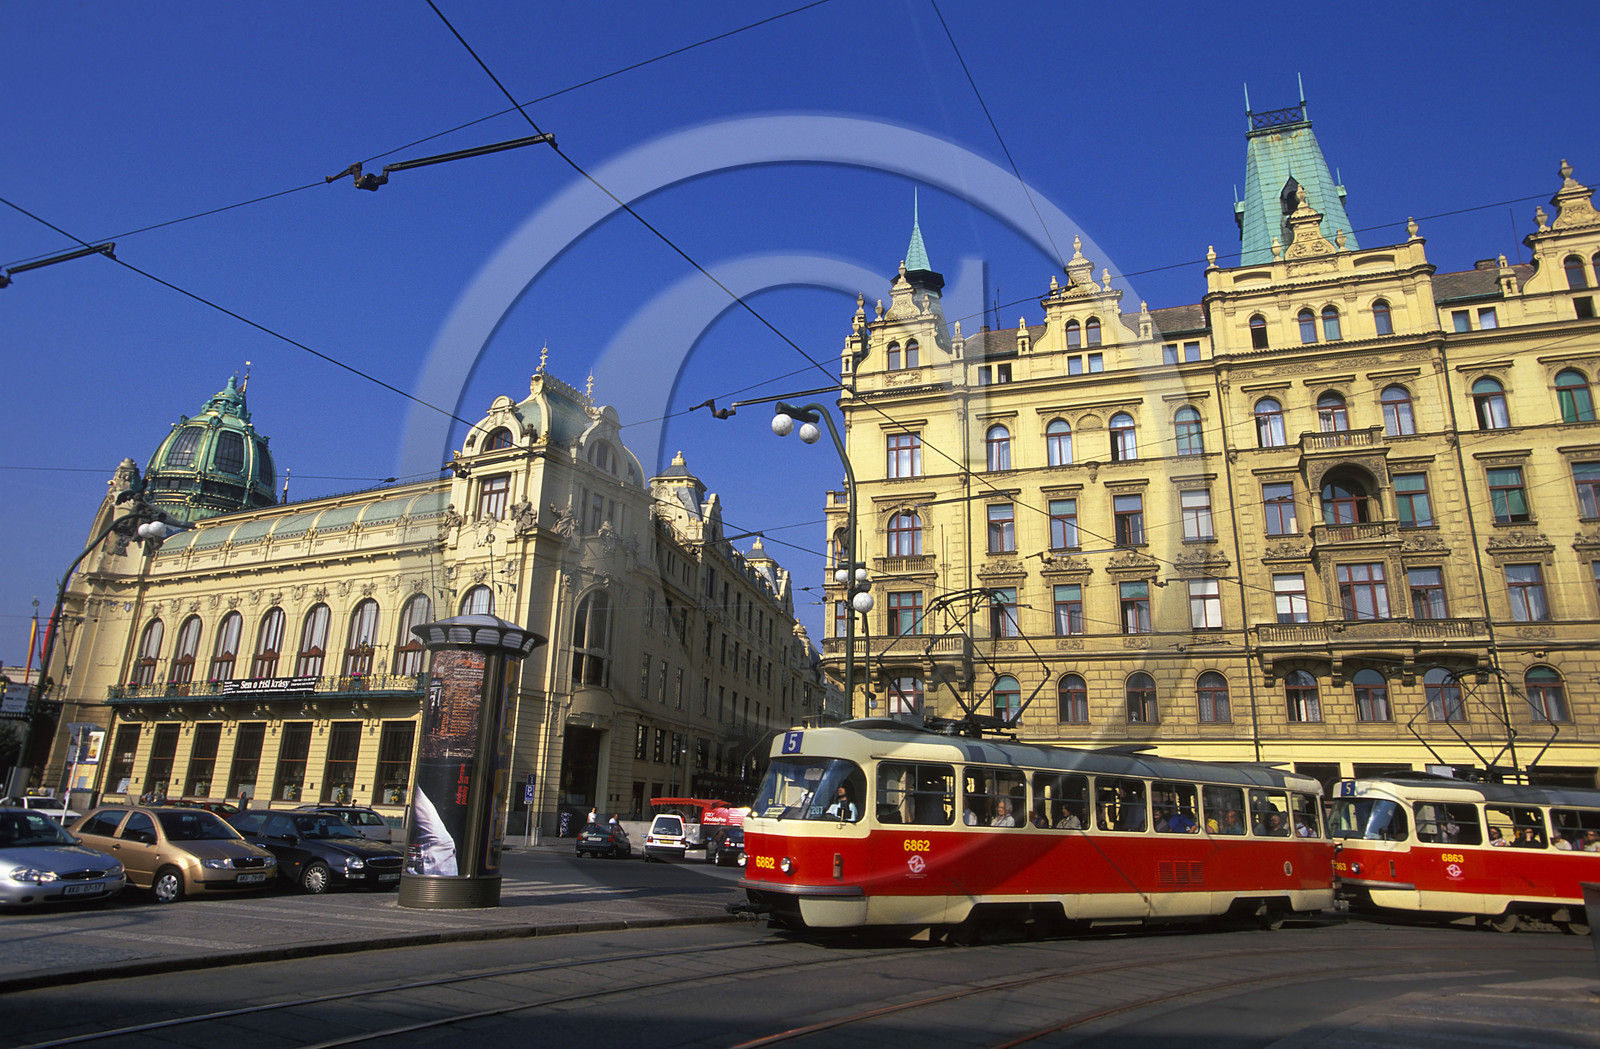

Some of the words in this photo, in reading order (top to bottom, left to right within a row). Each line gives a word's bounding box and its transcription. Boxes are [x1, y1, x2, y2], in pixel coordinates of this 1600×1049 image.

[240, 680, 252, 689] Sen
[252, 681, 258, 689] o
[270, 679, 291, 689] krásy
[788, 733, 798, 752] 5
[457, 762, 466, 784] Serrano
[1345, 782, 1352, 795] 5
[903, 839, 930, 852] 6862
[755, 855, 775, 869] 6862
[1441, 853, 1464, 863] 6863
